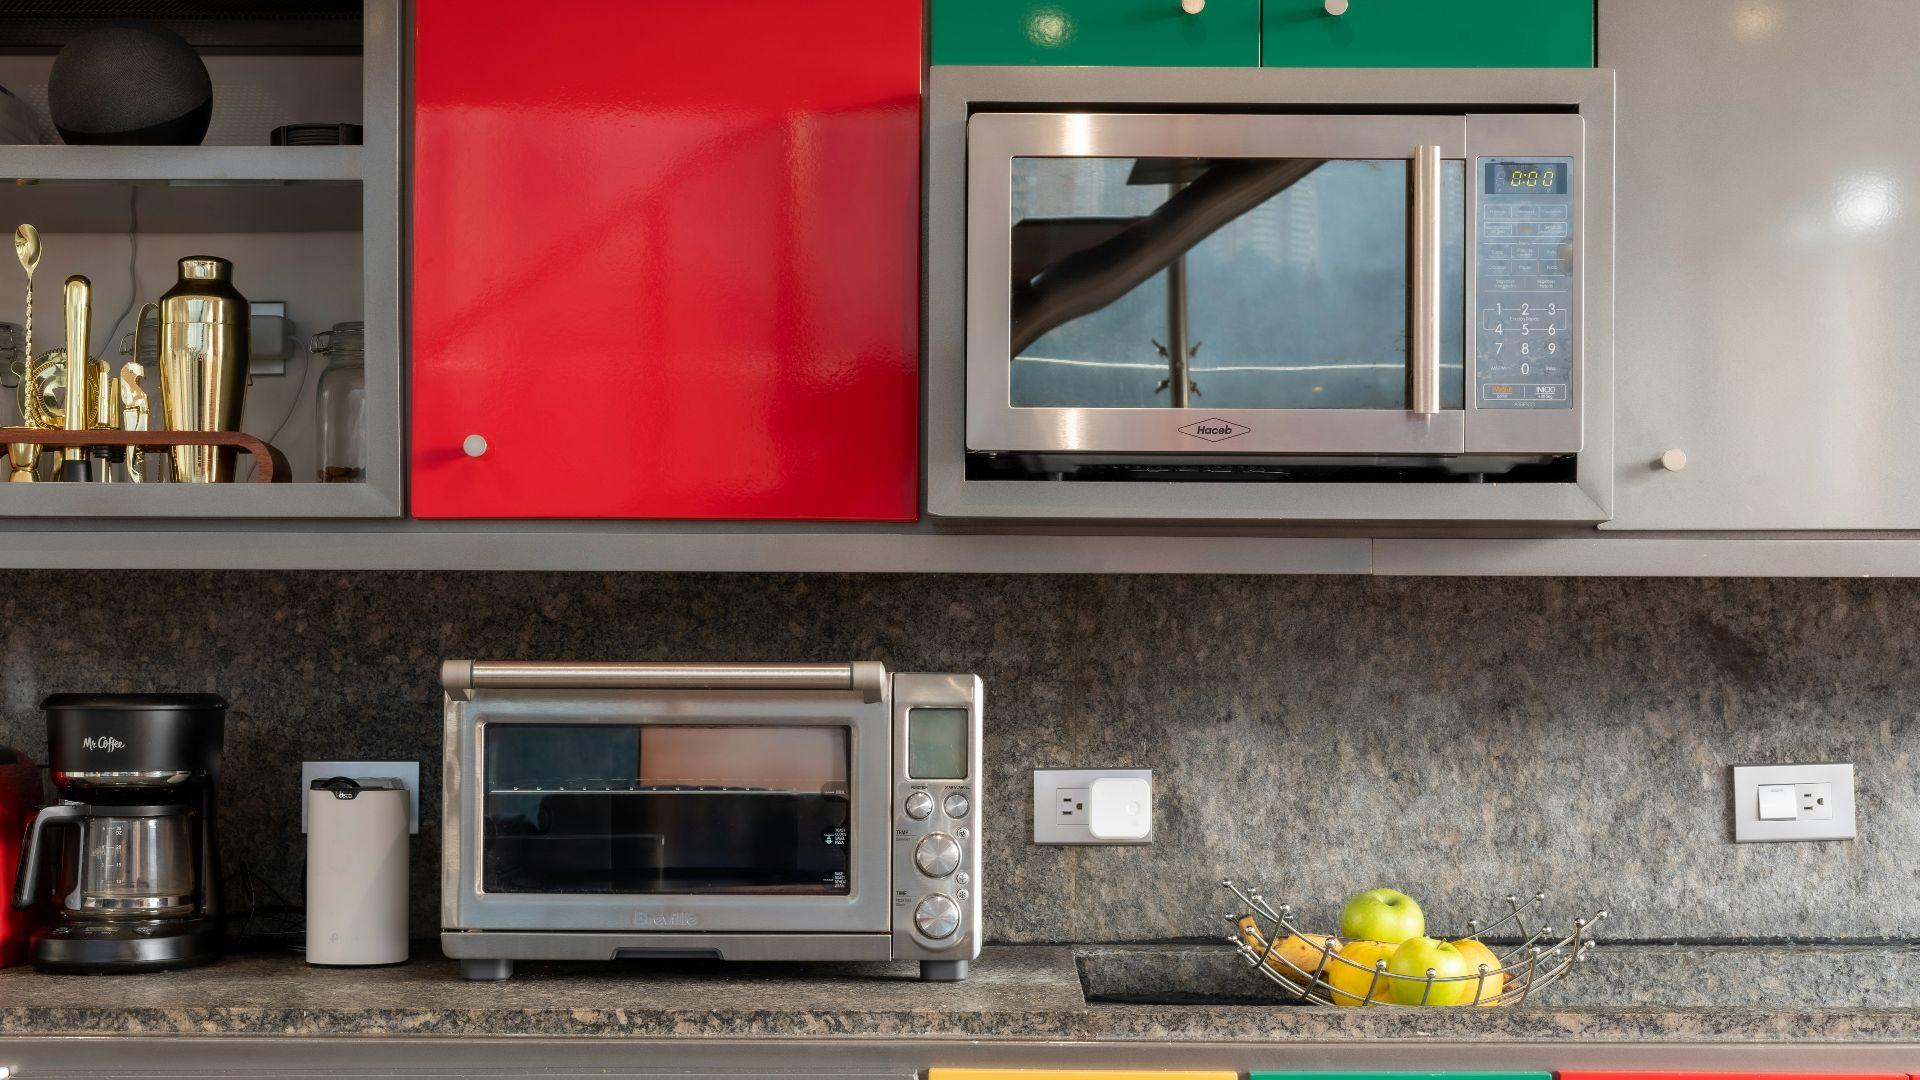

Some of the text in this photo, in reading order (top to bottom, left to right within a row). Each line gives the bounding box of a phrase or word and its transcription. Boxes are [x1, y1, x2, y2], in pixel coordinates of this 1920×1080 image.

[1511, 171, 1553, 186] 0:00
[1496, 303, 1556, 315] 1 2 3
[1494, 324, 1556, 335] 4 5 6
[1495, 343, 1556, 354] 7 8 9
[1521, 363, 1529, 375] 0
[1197, 425, 1232, 434] Haceb
[98, 736, 126, 752] Coffee
